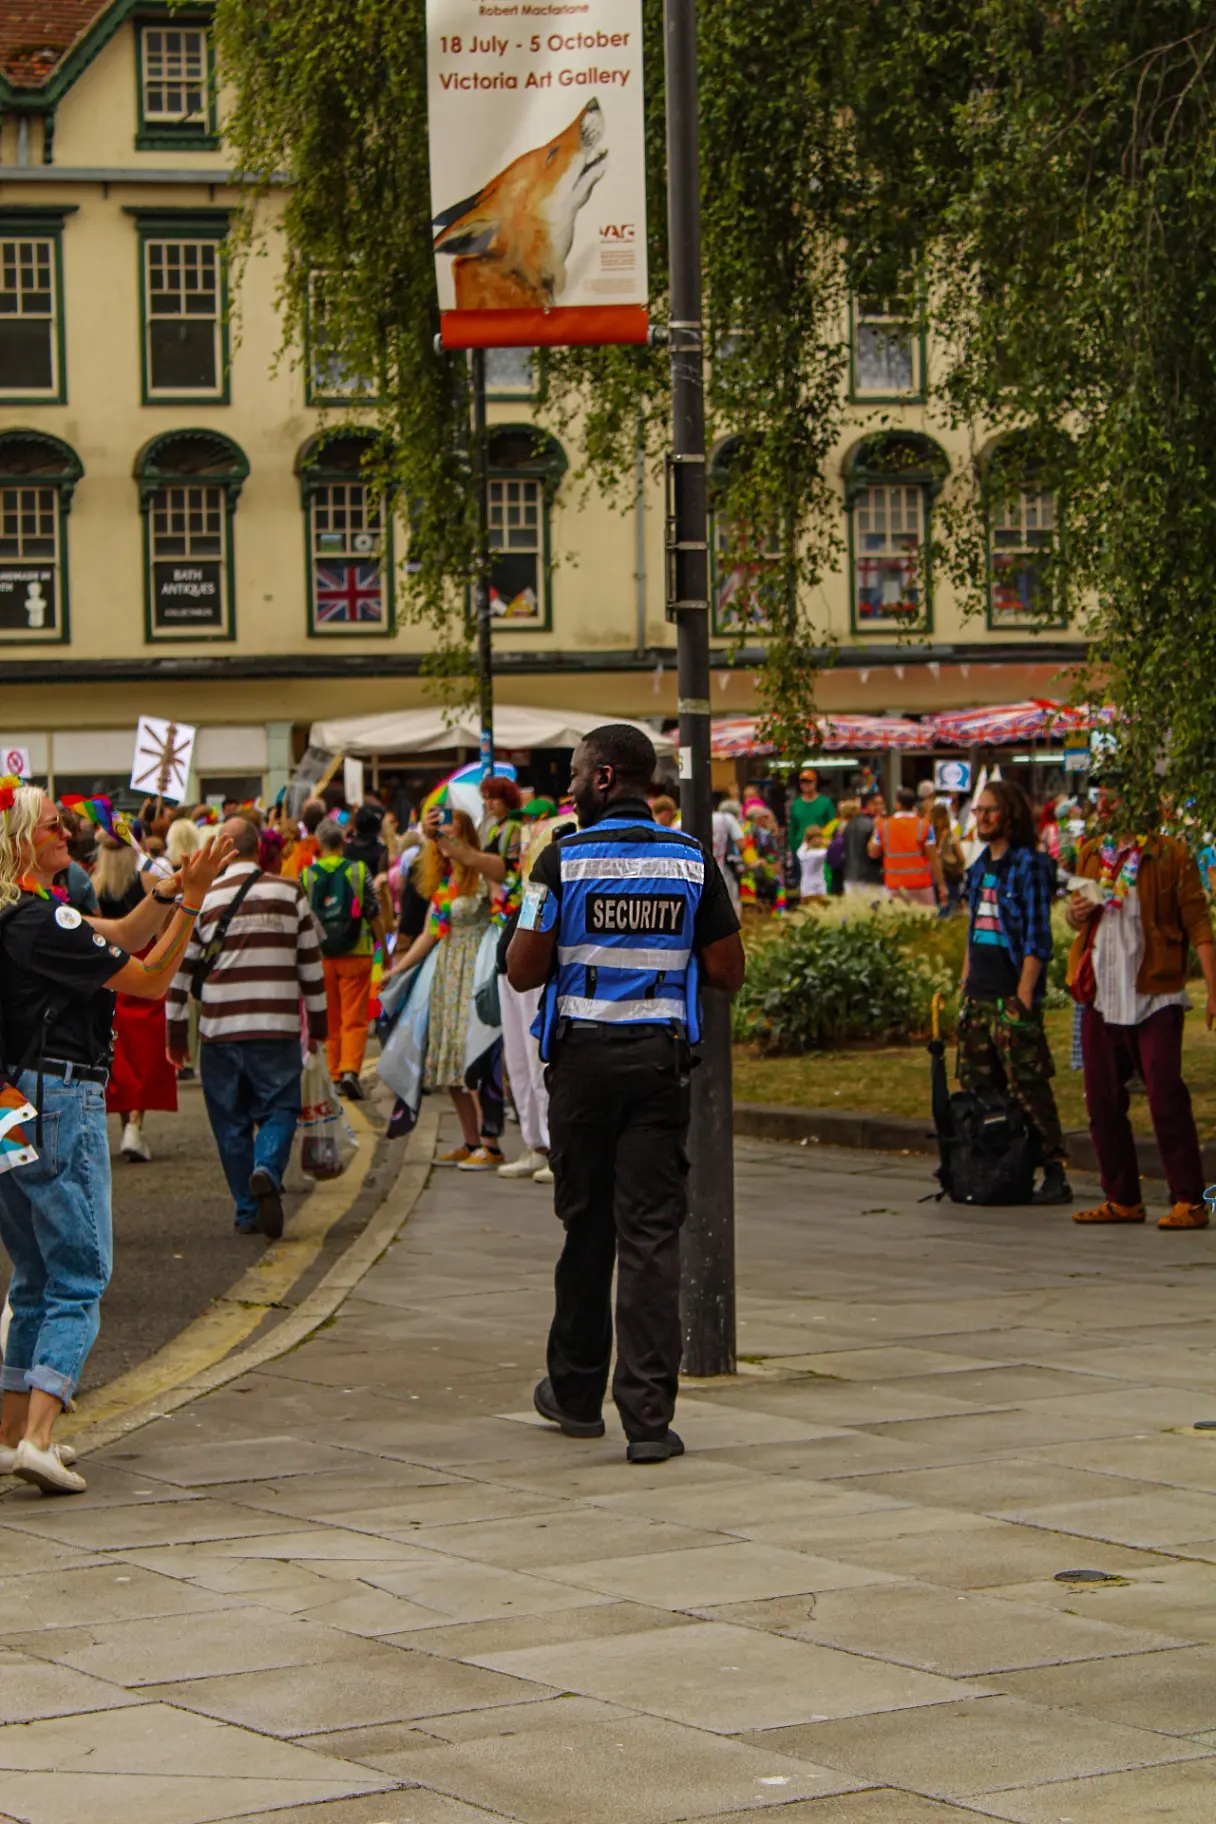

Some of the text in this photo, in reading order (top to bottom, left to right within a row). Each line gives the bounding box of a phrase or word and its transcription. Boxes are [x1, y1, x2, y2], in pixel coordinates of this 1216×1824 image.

[478, 3, 589, 16] Robert Macfarlane
[439, 35, 463, 54] 18
[468, 35, 509, 56] July
[529, 34, 541, 52] 5
[547, 31, 630, 52] October
[438, 67, 631, 90] Victoria Art Gallery
[173, 569, 203, 581] BATH
[160, 582, 216, 598] ANTIQUES
[593, 899, 682, 930] SECURITY
